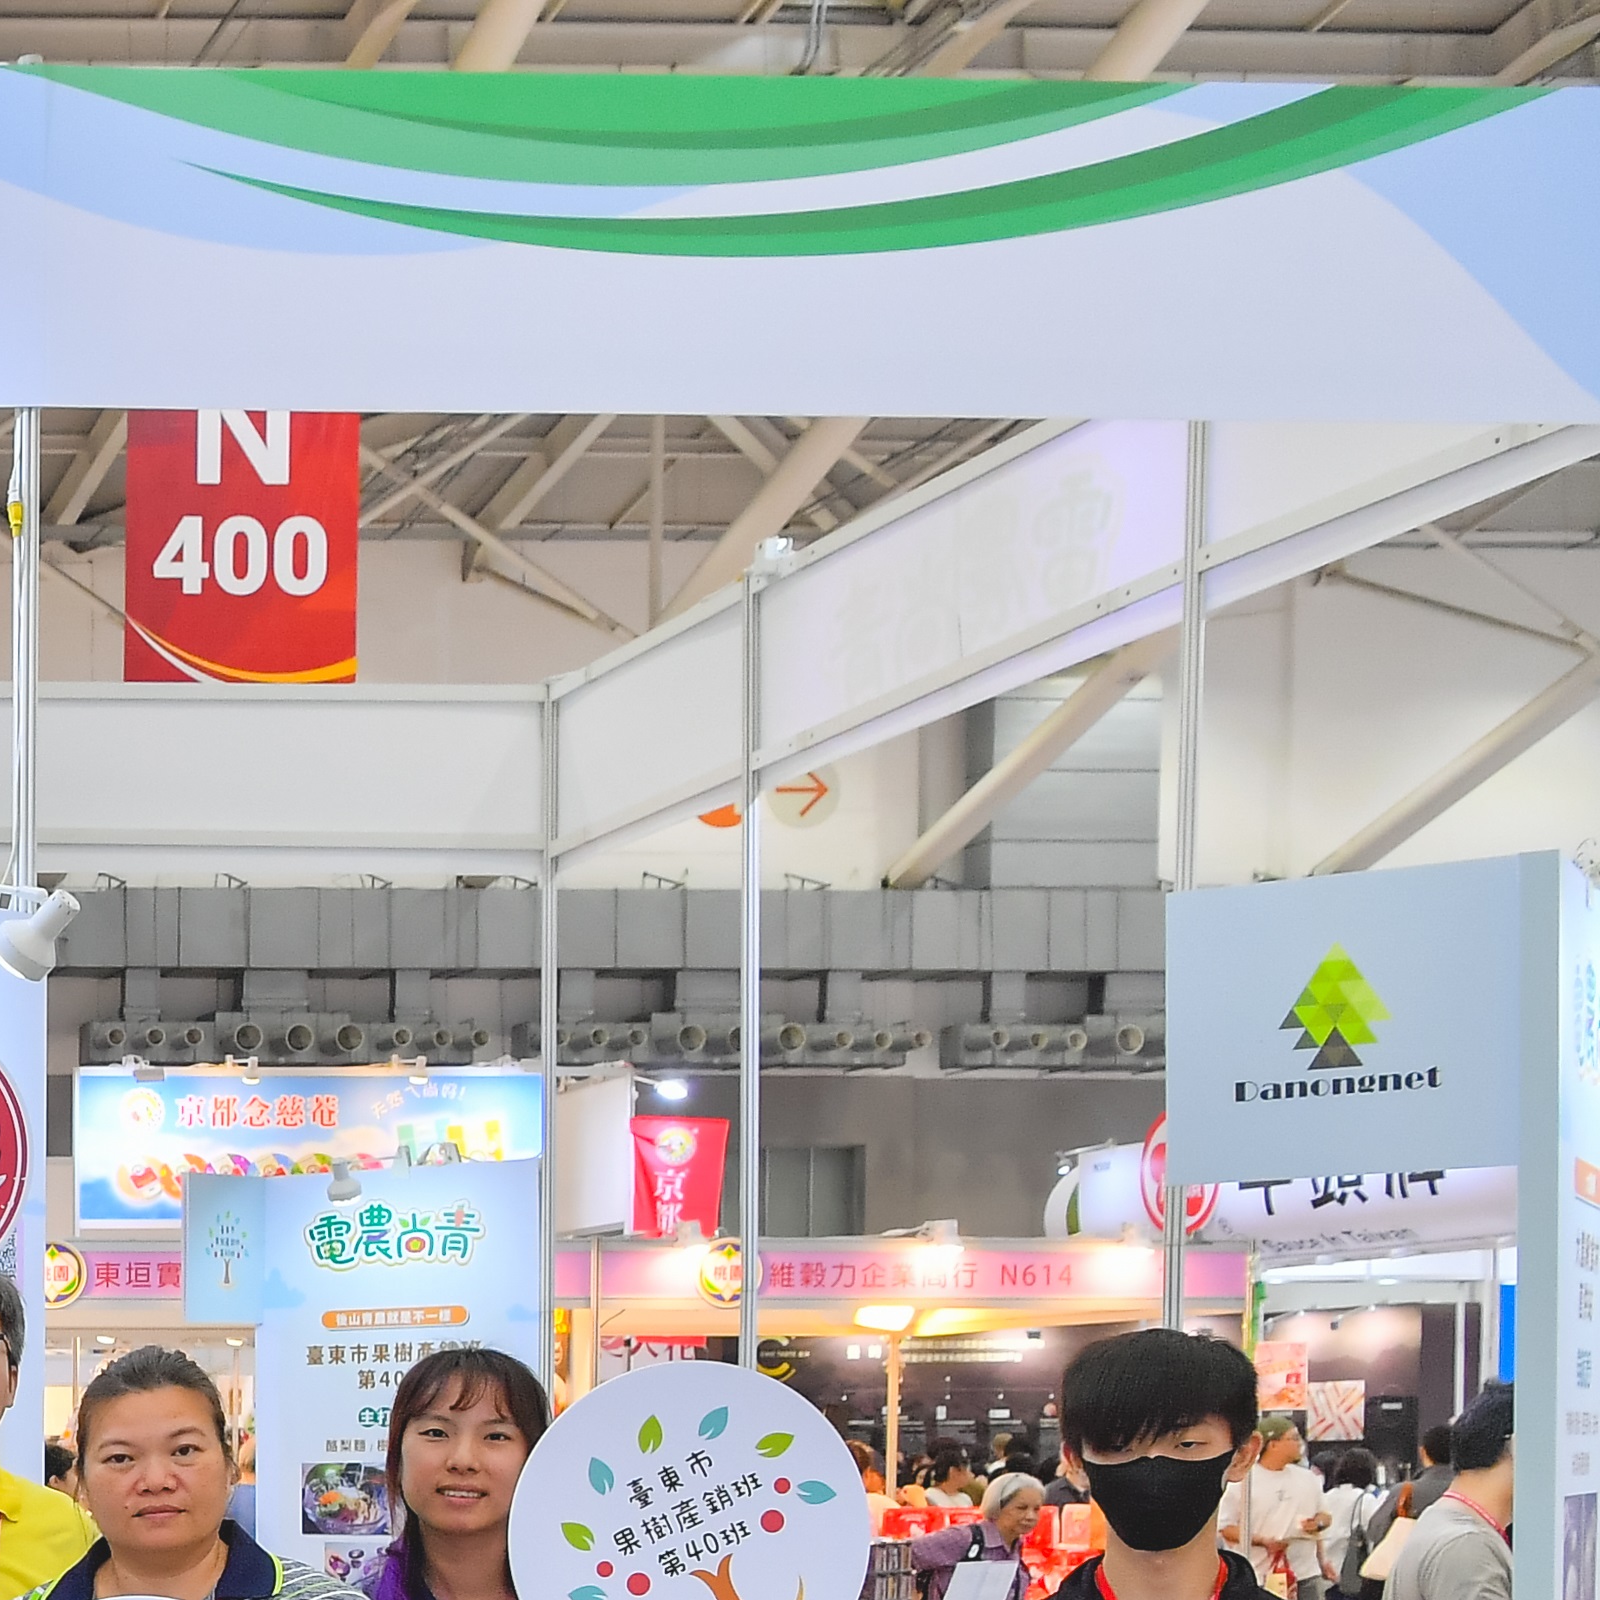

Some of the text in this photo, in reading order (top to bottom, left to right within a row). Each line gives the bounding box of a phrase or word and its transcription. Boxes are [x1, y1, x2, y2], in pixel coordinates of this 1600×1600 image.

[197, 410, 291, 486] N
[152, 514, 328, 596] 400
[1233, 1065, 1443, 1104] Danongnet
[309, 1202, 481, 1264] 電農尚青
[1001, 1264, 1073, 1287] N614
[626, 1449, 713, 1510] 臺東市
[613, 1472, 763, 1556] 果樹產銷班
[657, 1520, 752, 1577] 第40班
